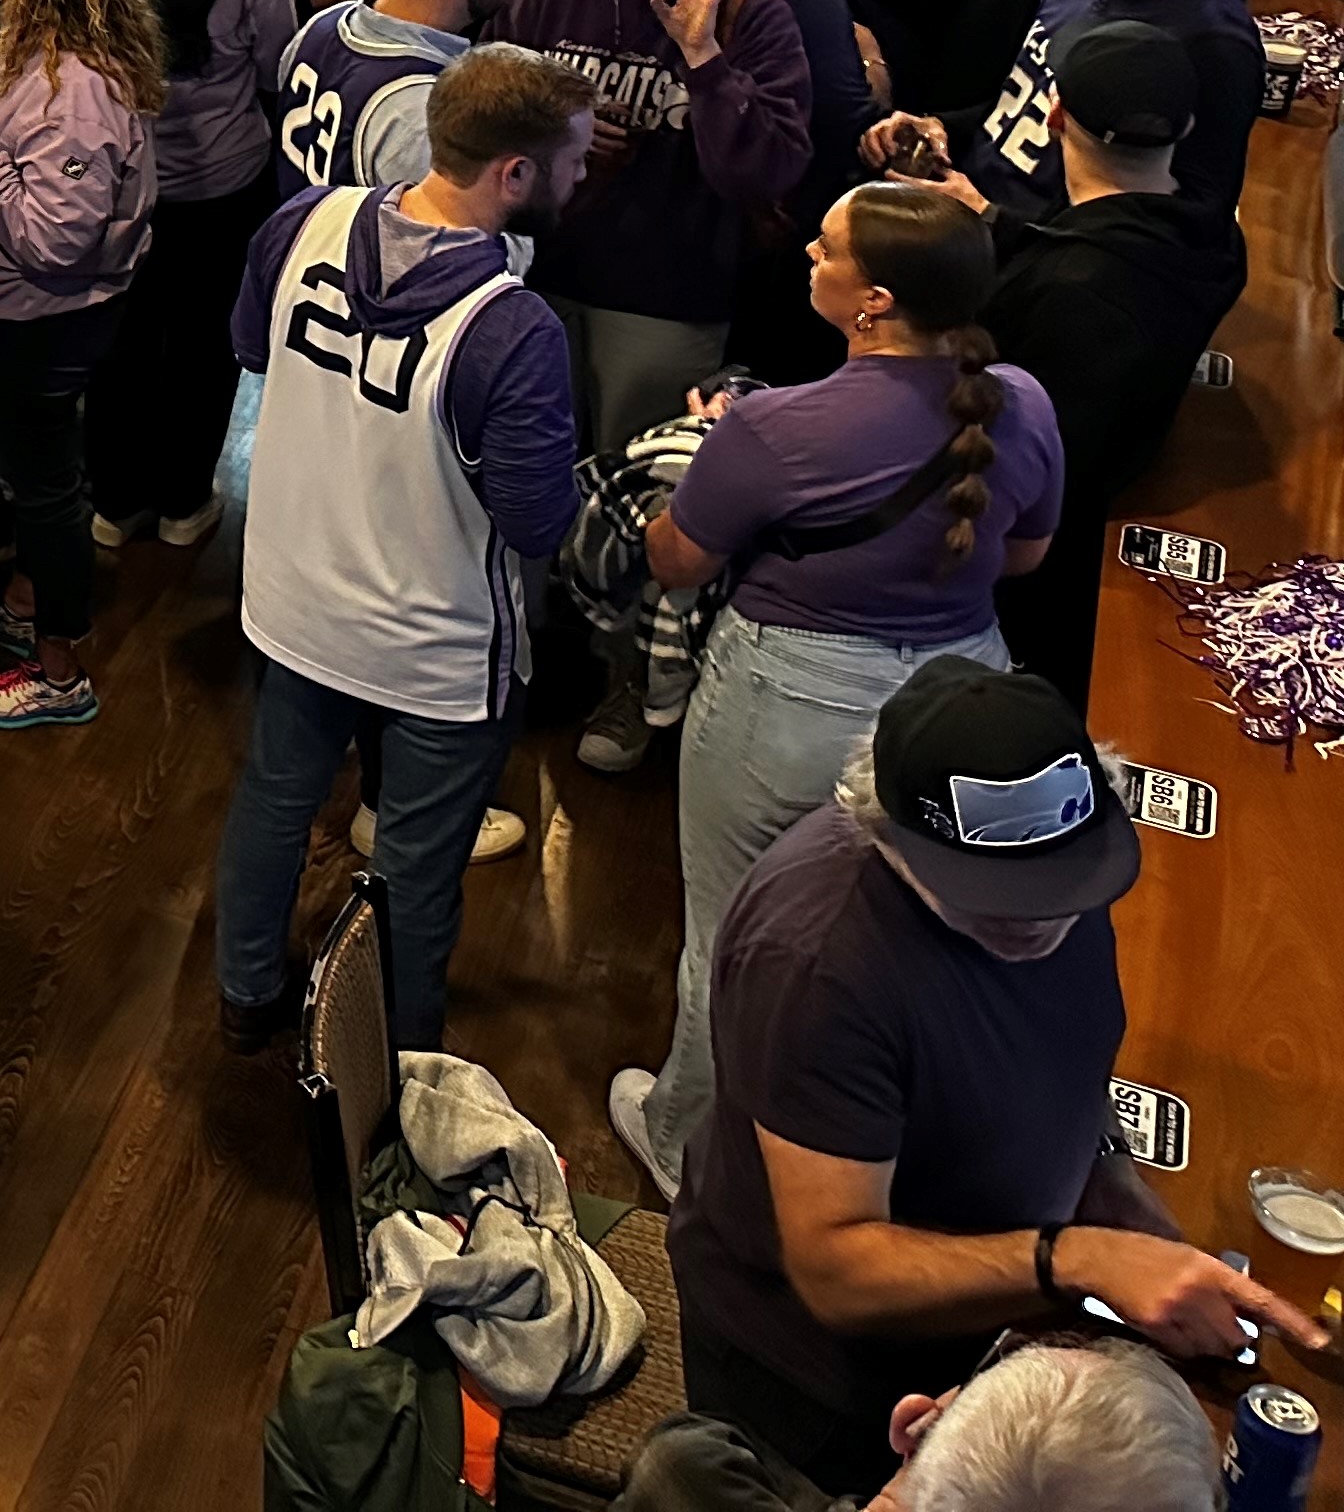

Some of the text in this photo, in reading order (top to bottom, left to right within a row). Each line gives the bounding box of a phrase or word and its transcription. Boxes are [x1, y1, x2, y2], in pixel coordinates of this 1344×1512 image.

[281, 61, 342, 187] 23
[983, 64, 1052, 175] 22
[284, 261, 429, 414] 20
[1166, 535, 1189, 561] SB5
[1150, 774, 1176, 806] SB6
[1115, 1086, 1142, 1129] SB7
